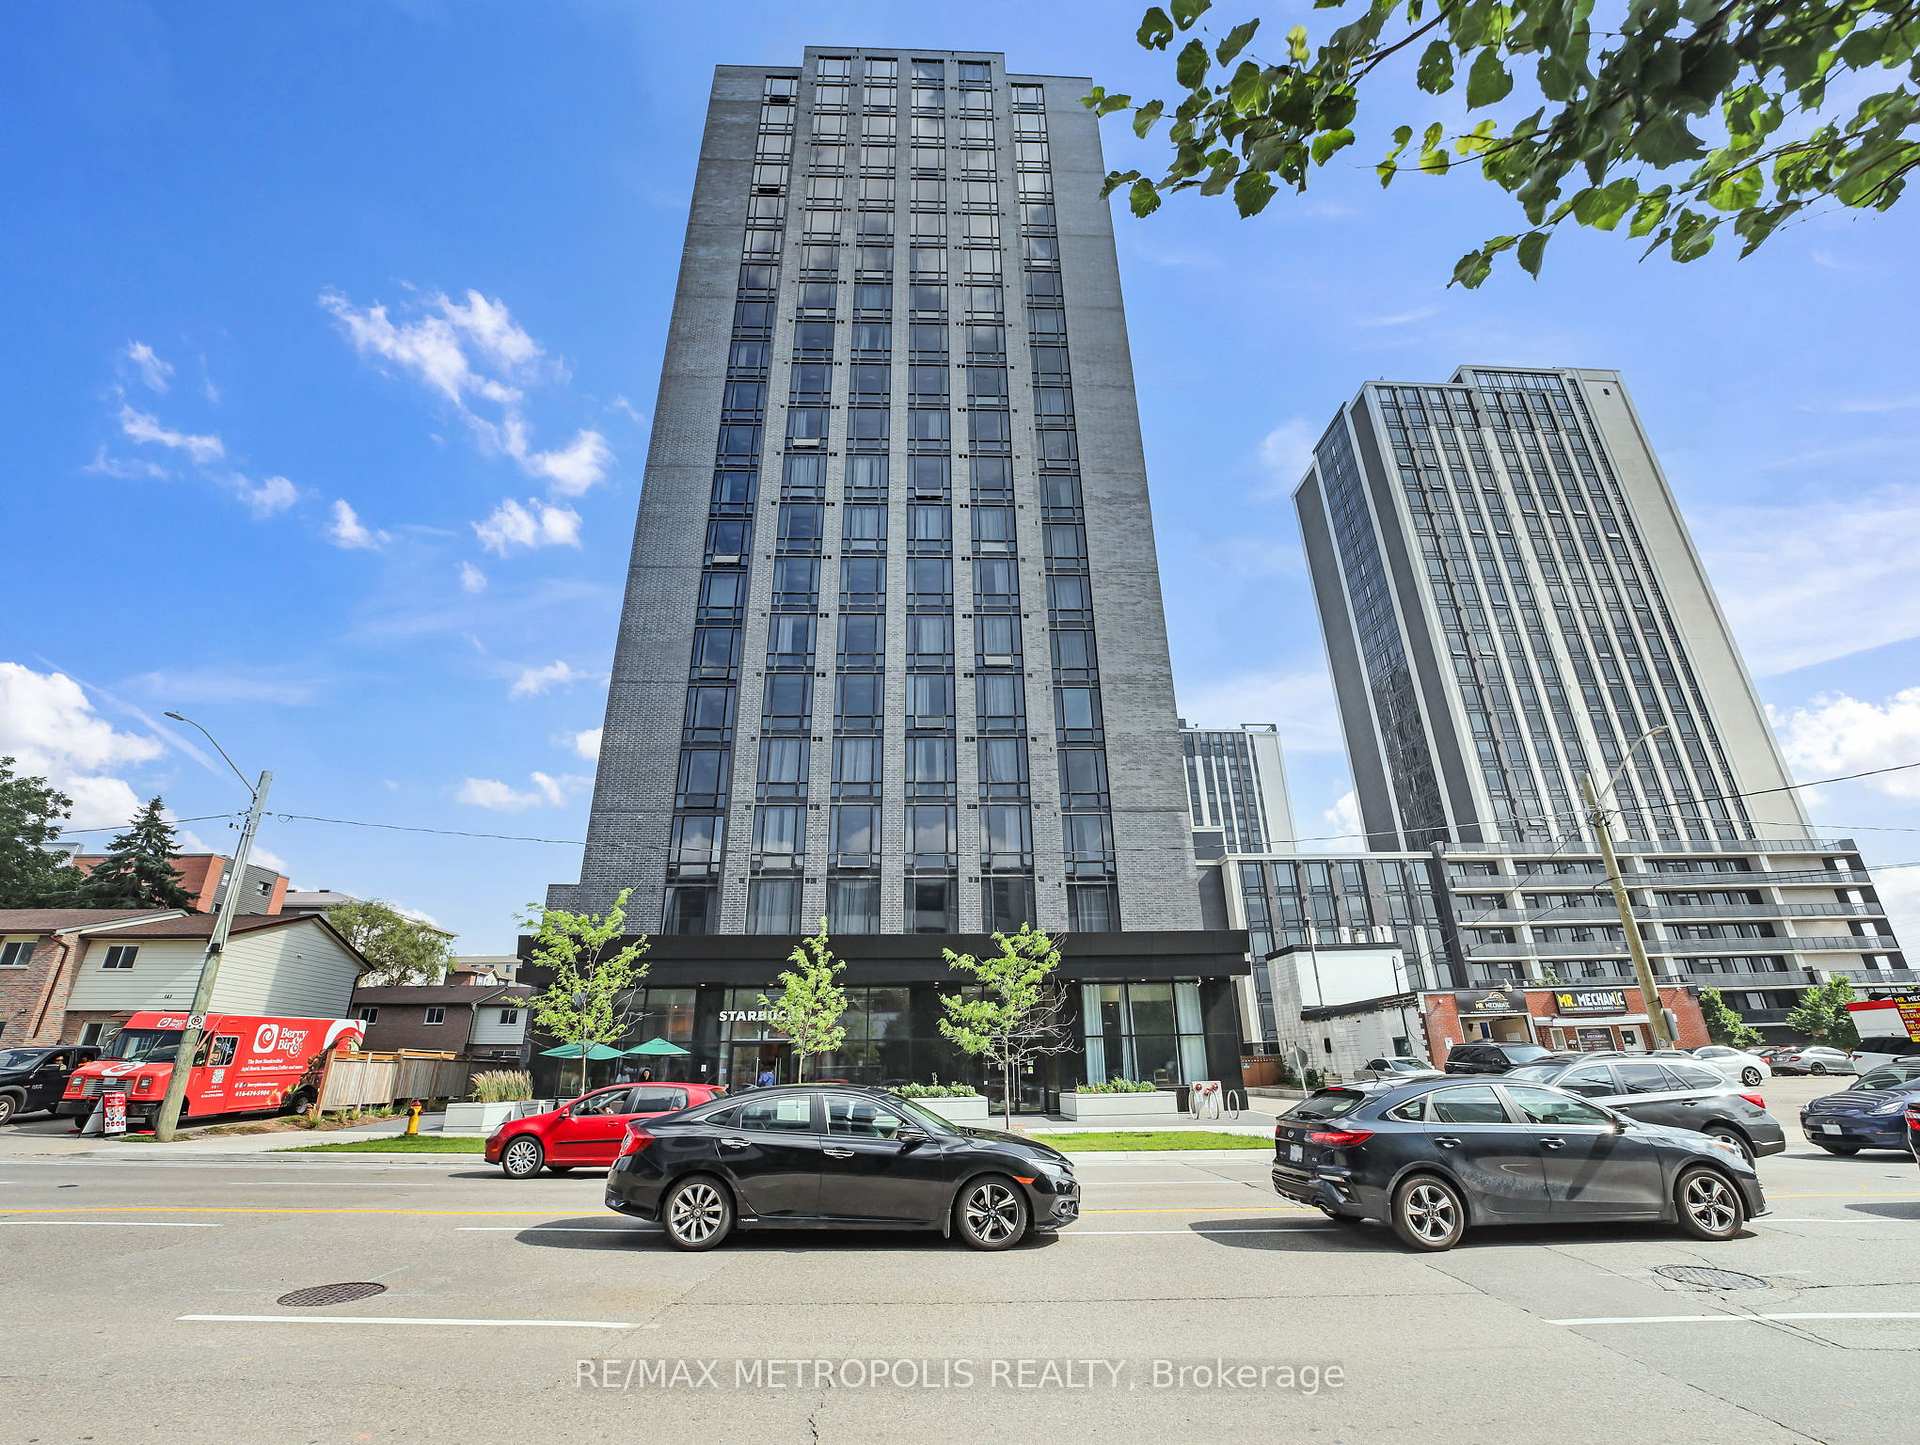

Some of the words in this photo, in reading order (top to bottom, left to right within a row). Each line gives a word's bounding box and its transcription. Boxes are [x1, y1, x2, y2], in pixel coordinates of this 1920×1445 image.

[1556, 993, 1577, 1007] MR.
[1577, 991, 1625, 1006] MECHANIC
[719, 1010, 794, 1021] STARBUC
[281, 1028, 308, 1041] Berry
